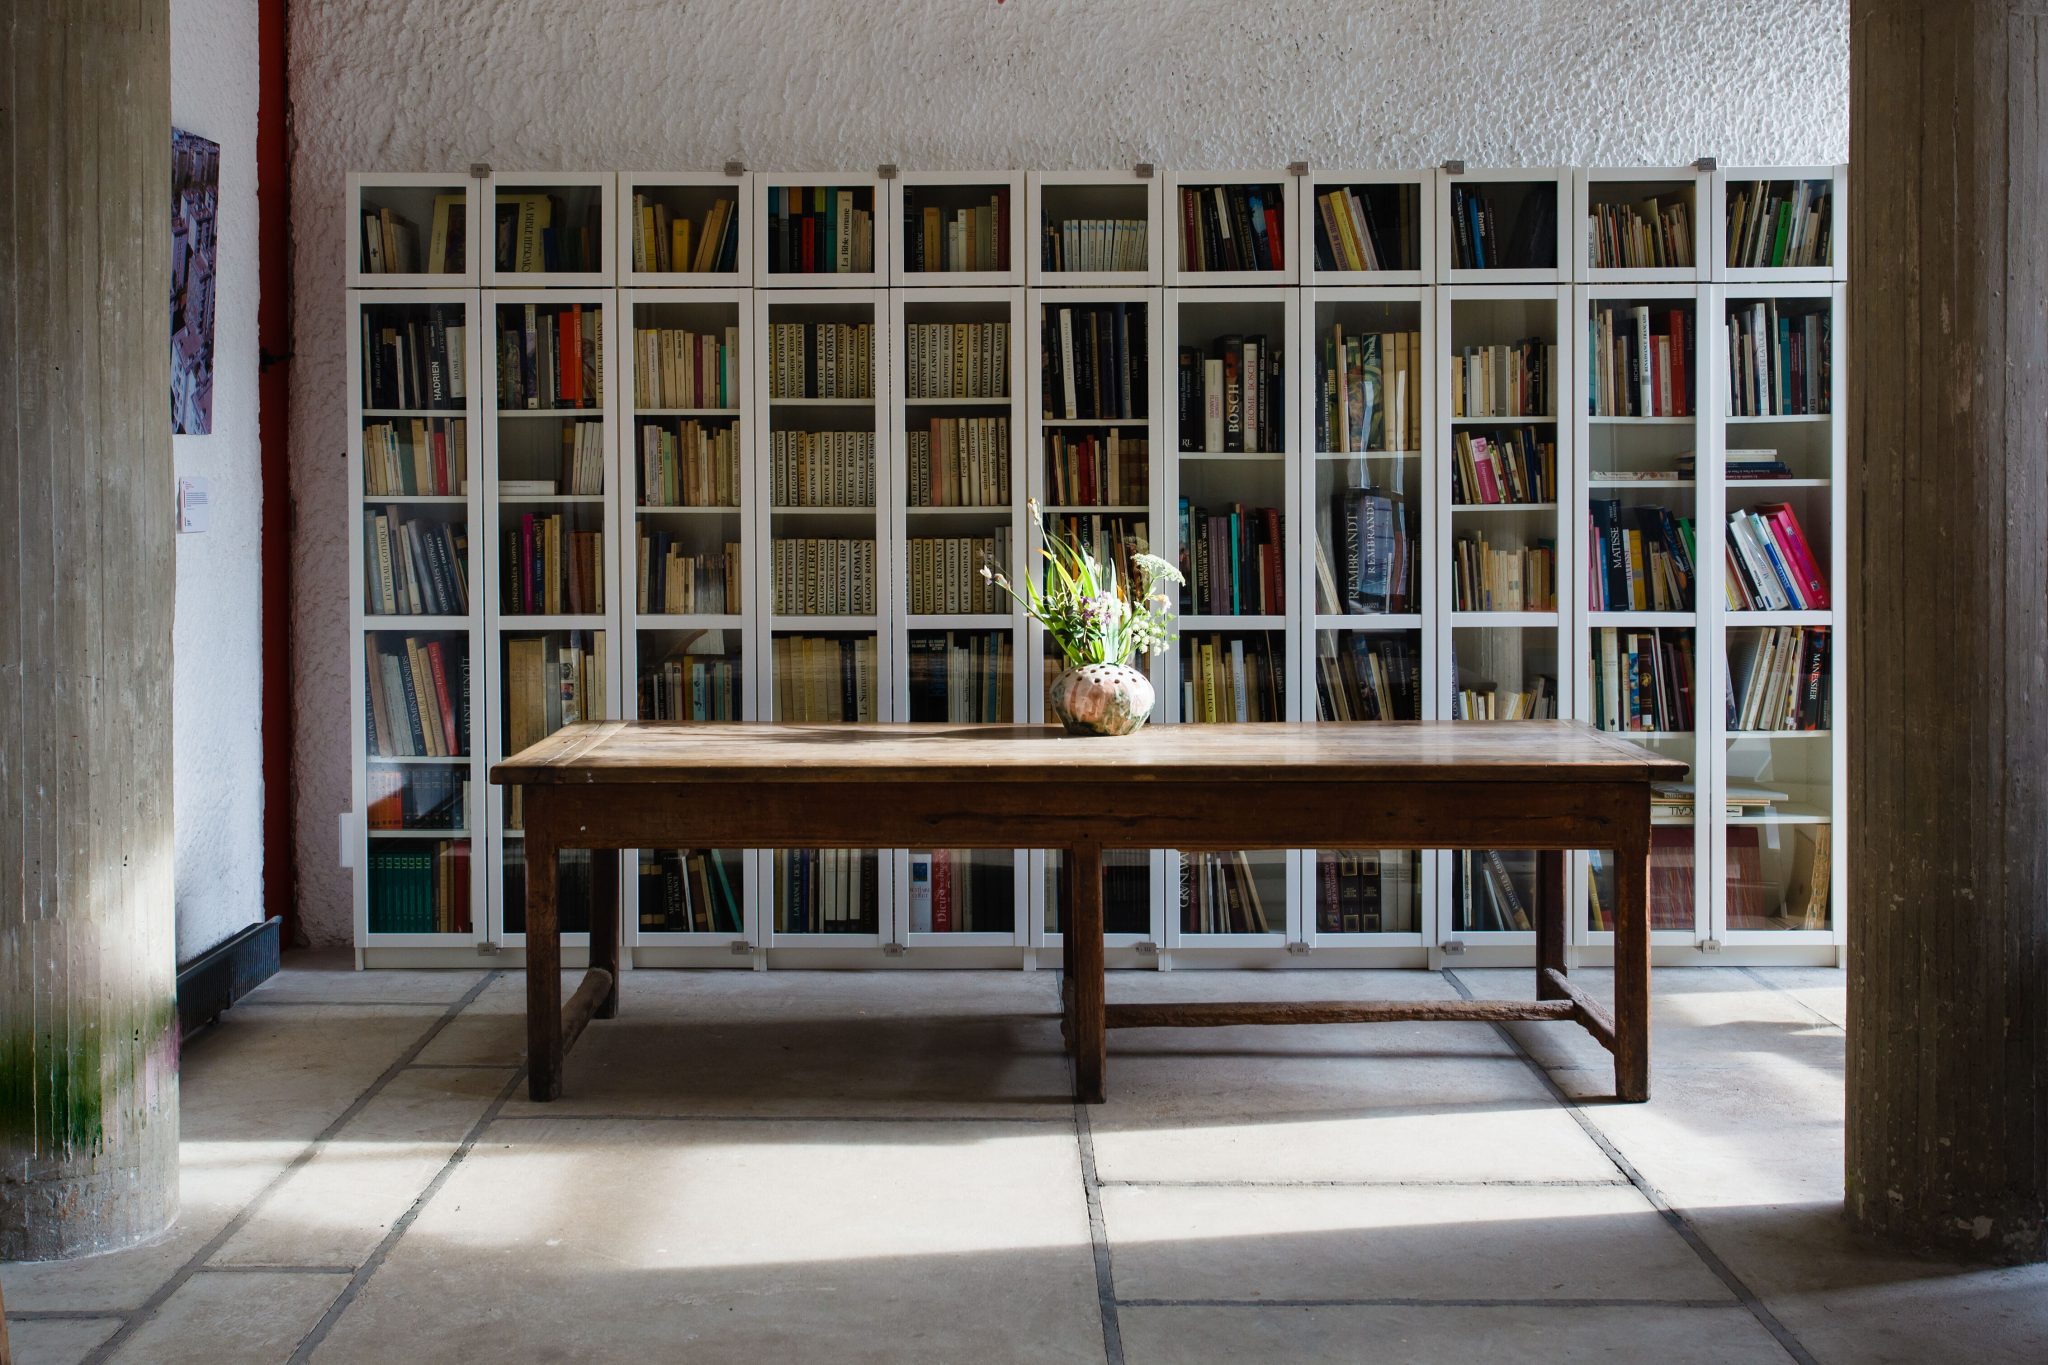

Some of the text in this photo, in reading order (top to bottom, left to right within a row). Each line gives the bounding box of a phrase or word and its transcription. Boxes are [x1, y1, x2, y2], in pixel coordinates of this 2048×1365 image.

[841, 258, 848, 267] La
[432, 361, 442, 401] HADRIEN
[1247, 360, 1255, 390] BOSCH
[1228, 384, 1239, 433] BOSCH
[847, 470, 855, 506] QUERCY
[1347, 512, 1360, 599] REMBRANDT
[1366, 499, 1376, 573] REMBRANDT
[1611, 527, 1622, 568] MATISSE
[854, 585, 862, 611] LEON
[1810, 653, 1820, 700] MANESSIER
[409, 693, 421, 735] JUGEMENTS
